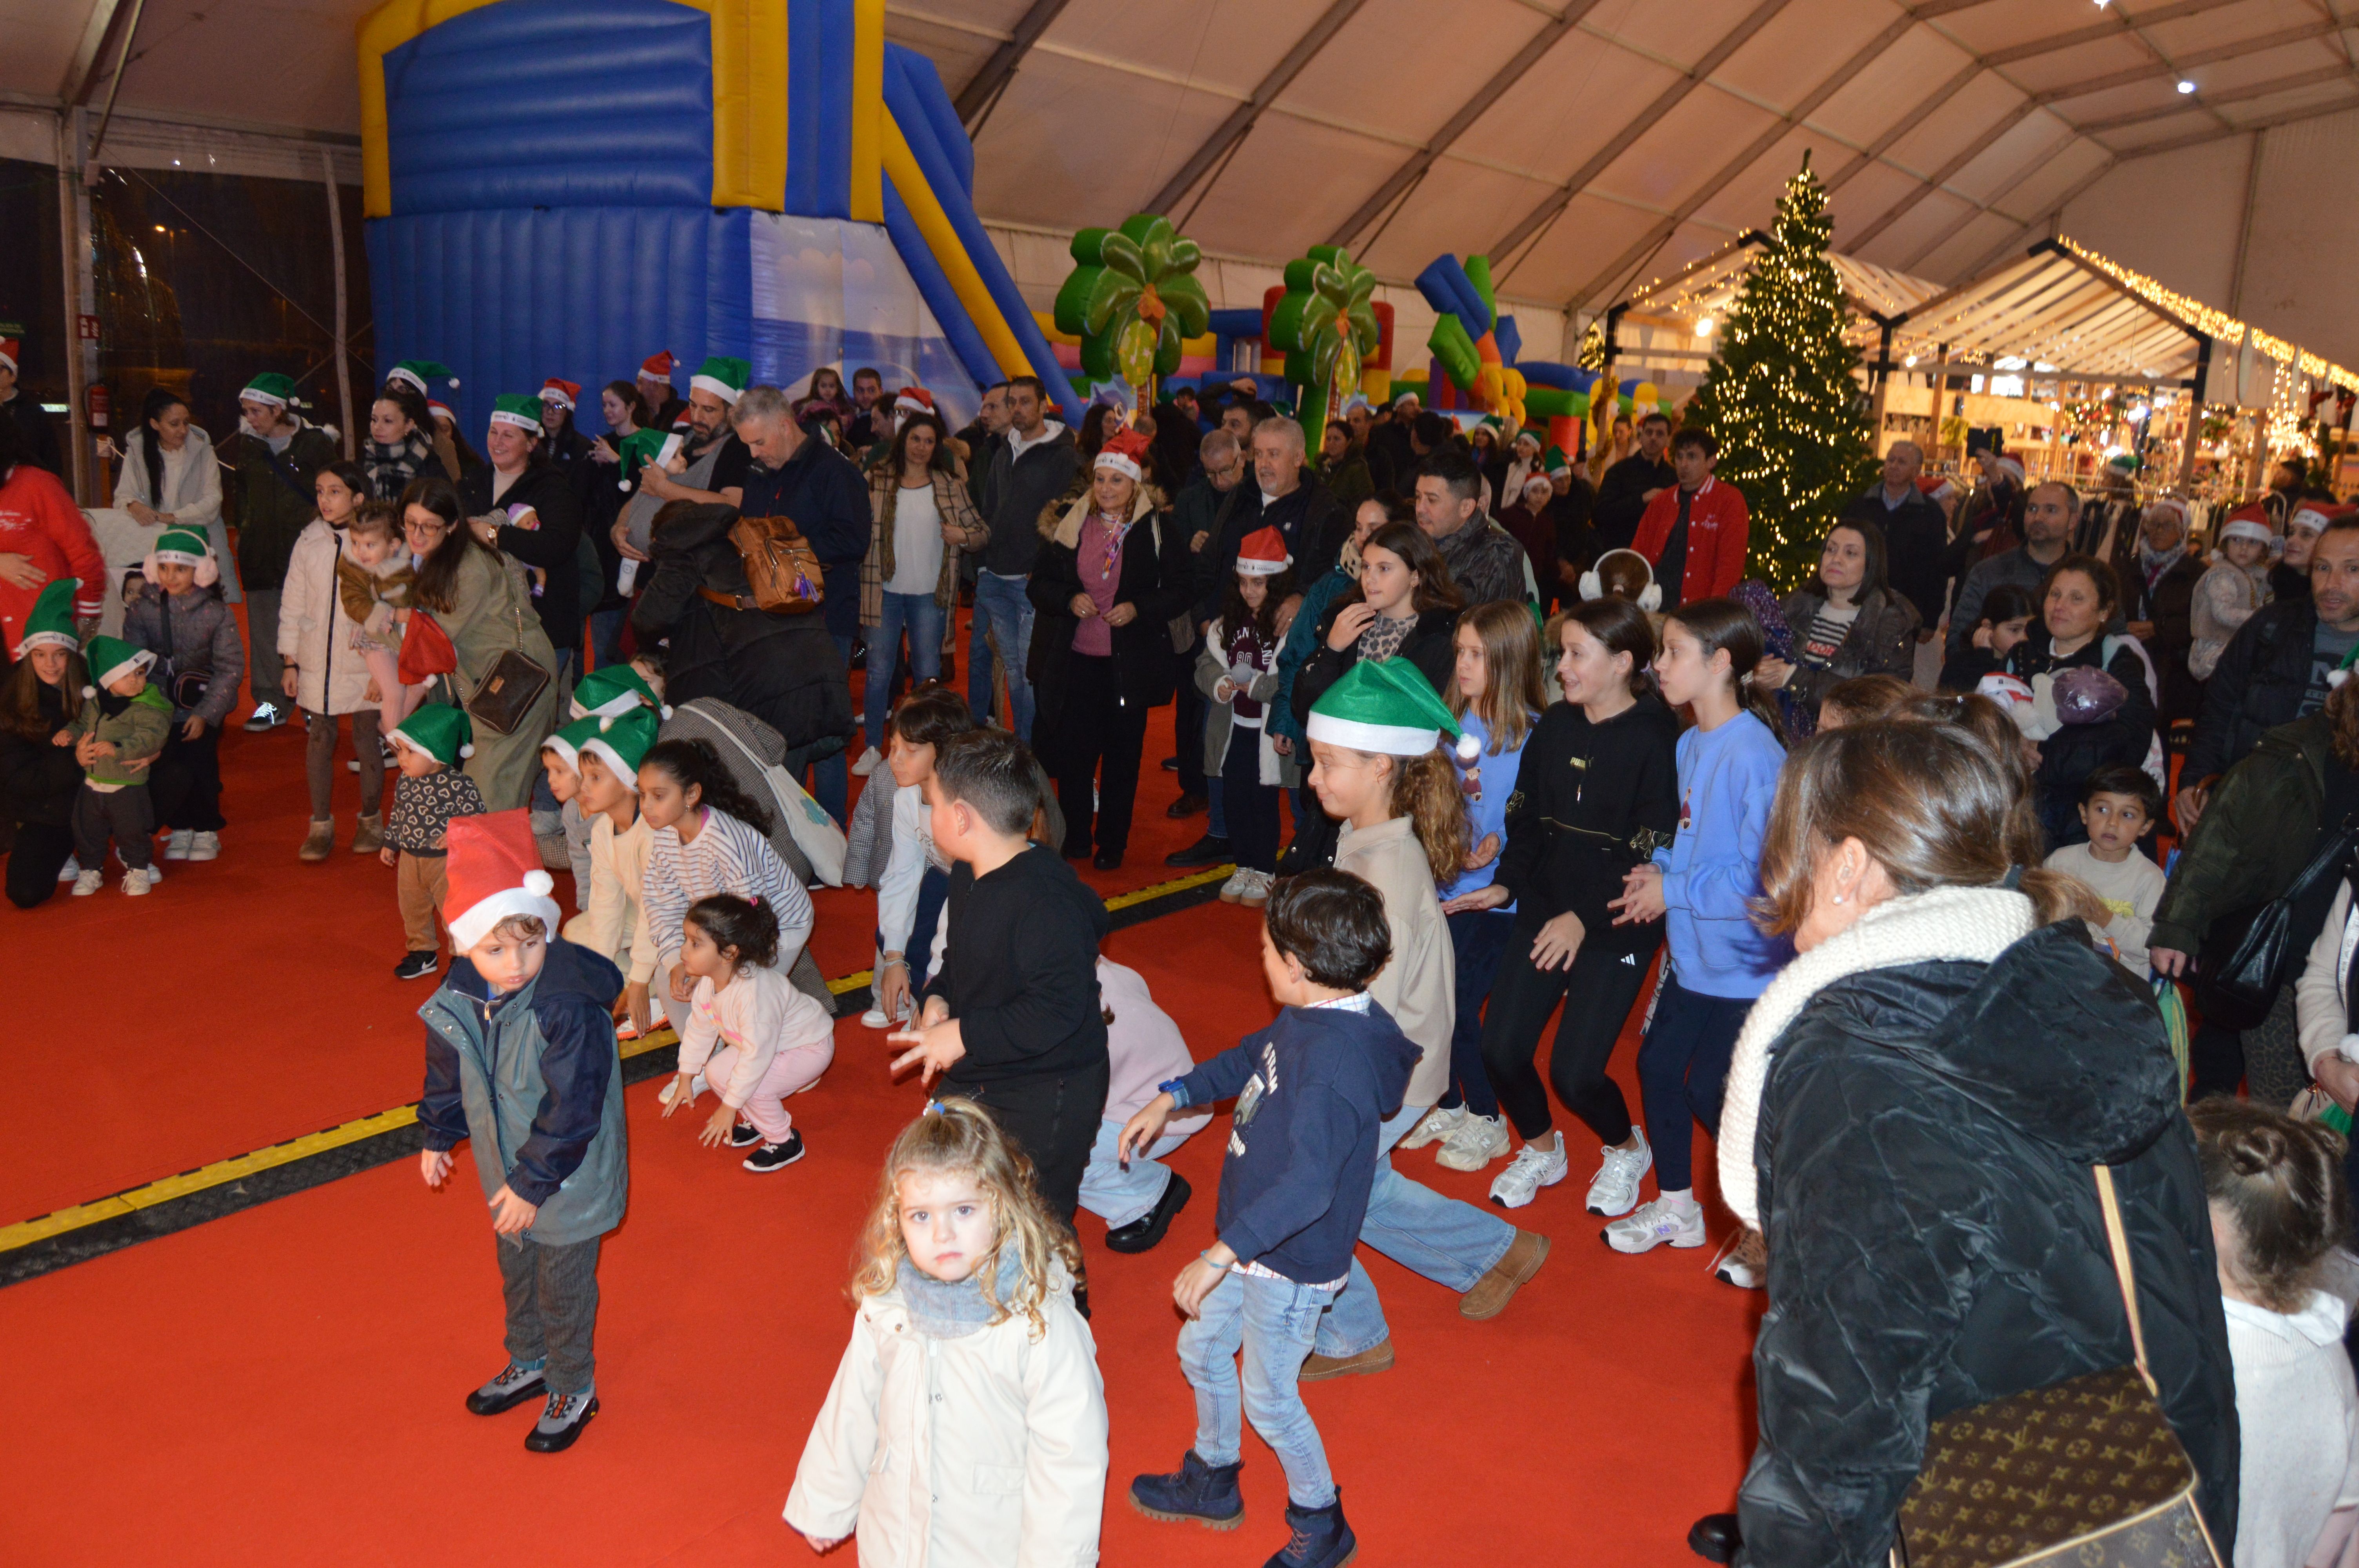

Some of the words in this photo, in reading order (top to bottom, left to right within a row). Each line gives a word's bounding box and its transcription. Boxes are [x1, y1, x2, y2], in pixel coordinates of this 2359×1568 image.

[1267, 1049, 1278, 1094] TEAM
[1231, 1130, 1246, 1157] TRIP
[1656, 1224, 1672, 1236] N
